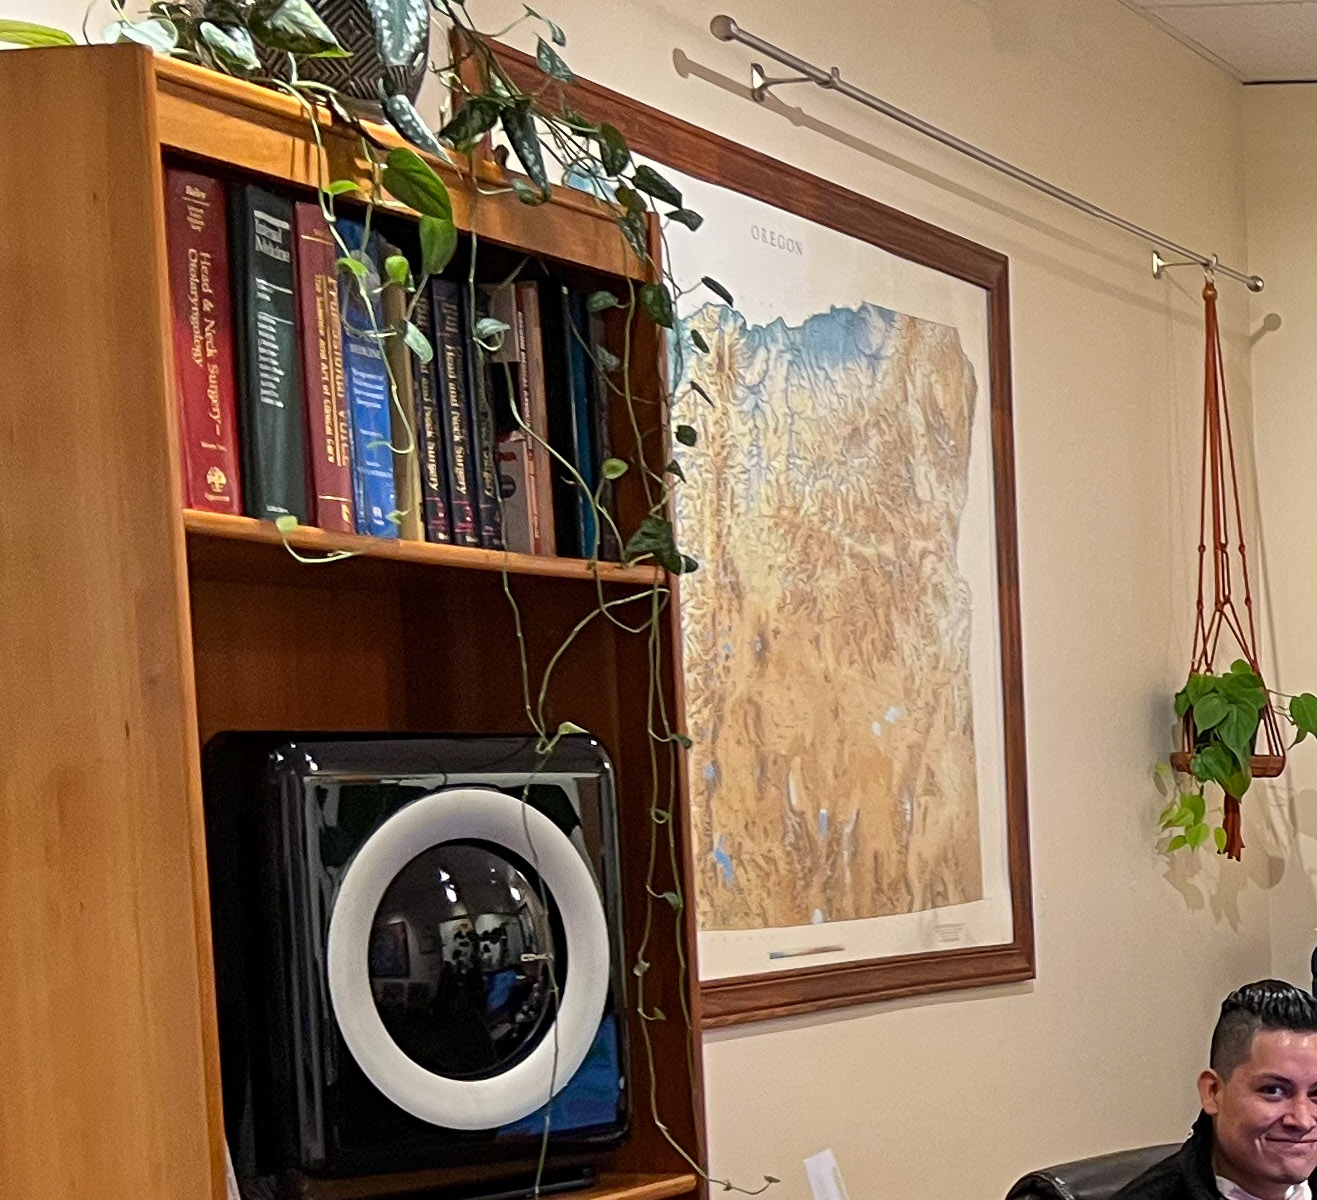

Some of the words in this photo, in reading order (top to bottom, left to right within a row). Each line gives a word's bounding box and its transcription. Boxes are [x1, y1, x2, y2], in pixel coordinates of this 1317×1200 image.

[750, 224, 803, 256] OREGON
[199, 252, 214, 294] Head
[187, 248, 205, 368] Otolaryngology
[203, 318, 218, 358] Neck
[444, 344, 458, 379] Head
[447, 382, 460, 407] and
[450, 410, 463, 442] Neck
[453, 445, 467, 495] Surgery
